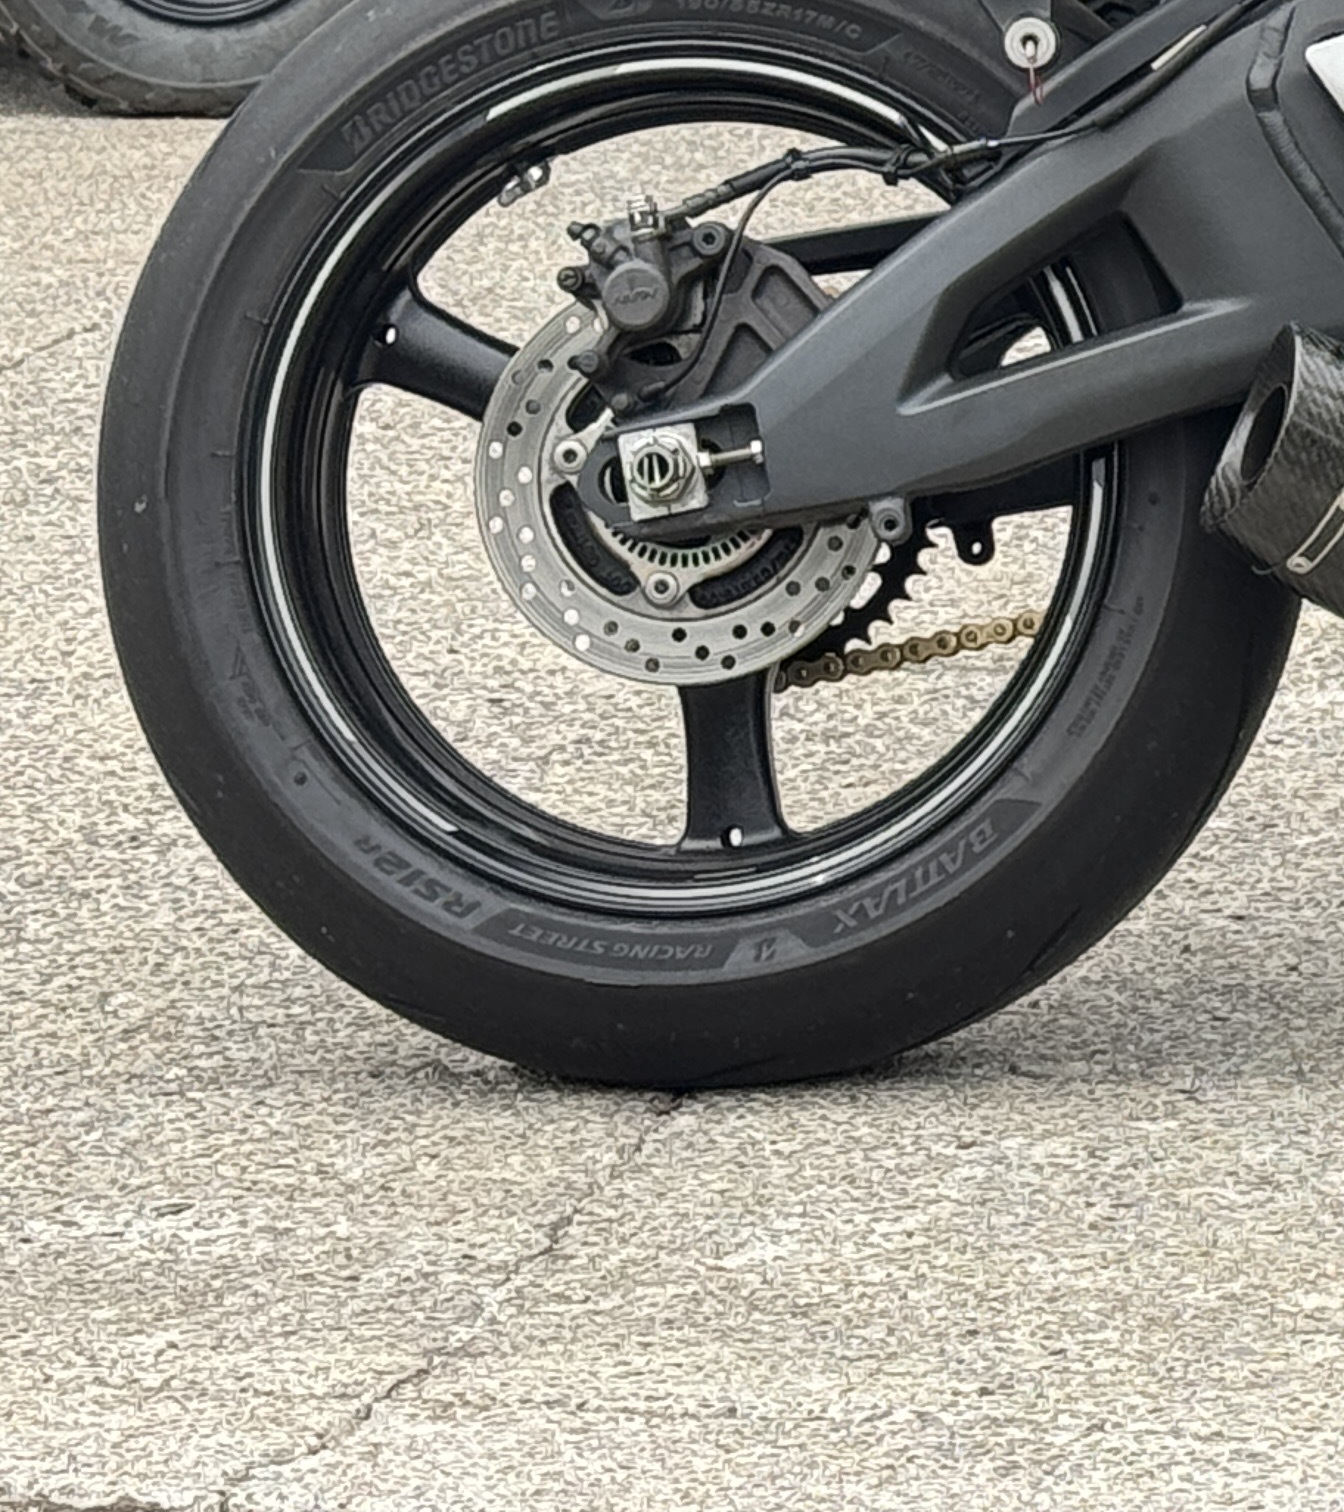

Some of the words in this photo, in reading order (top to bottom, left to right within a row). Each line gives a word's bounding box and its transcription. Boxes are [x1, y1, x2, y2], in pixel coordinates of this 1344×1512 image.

[340, 10, 560, 156] BRIDGESTONE
[832, 818, 999, 934] BATTLAX
[507, 921, 610, 956] STREET
[611, 942, 713, 960] RACING
